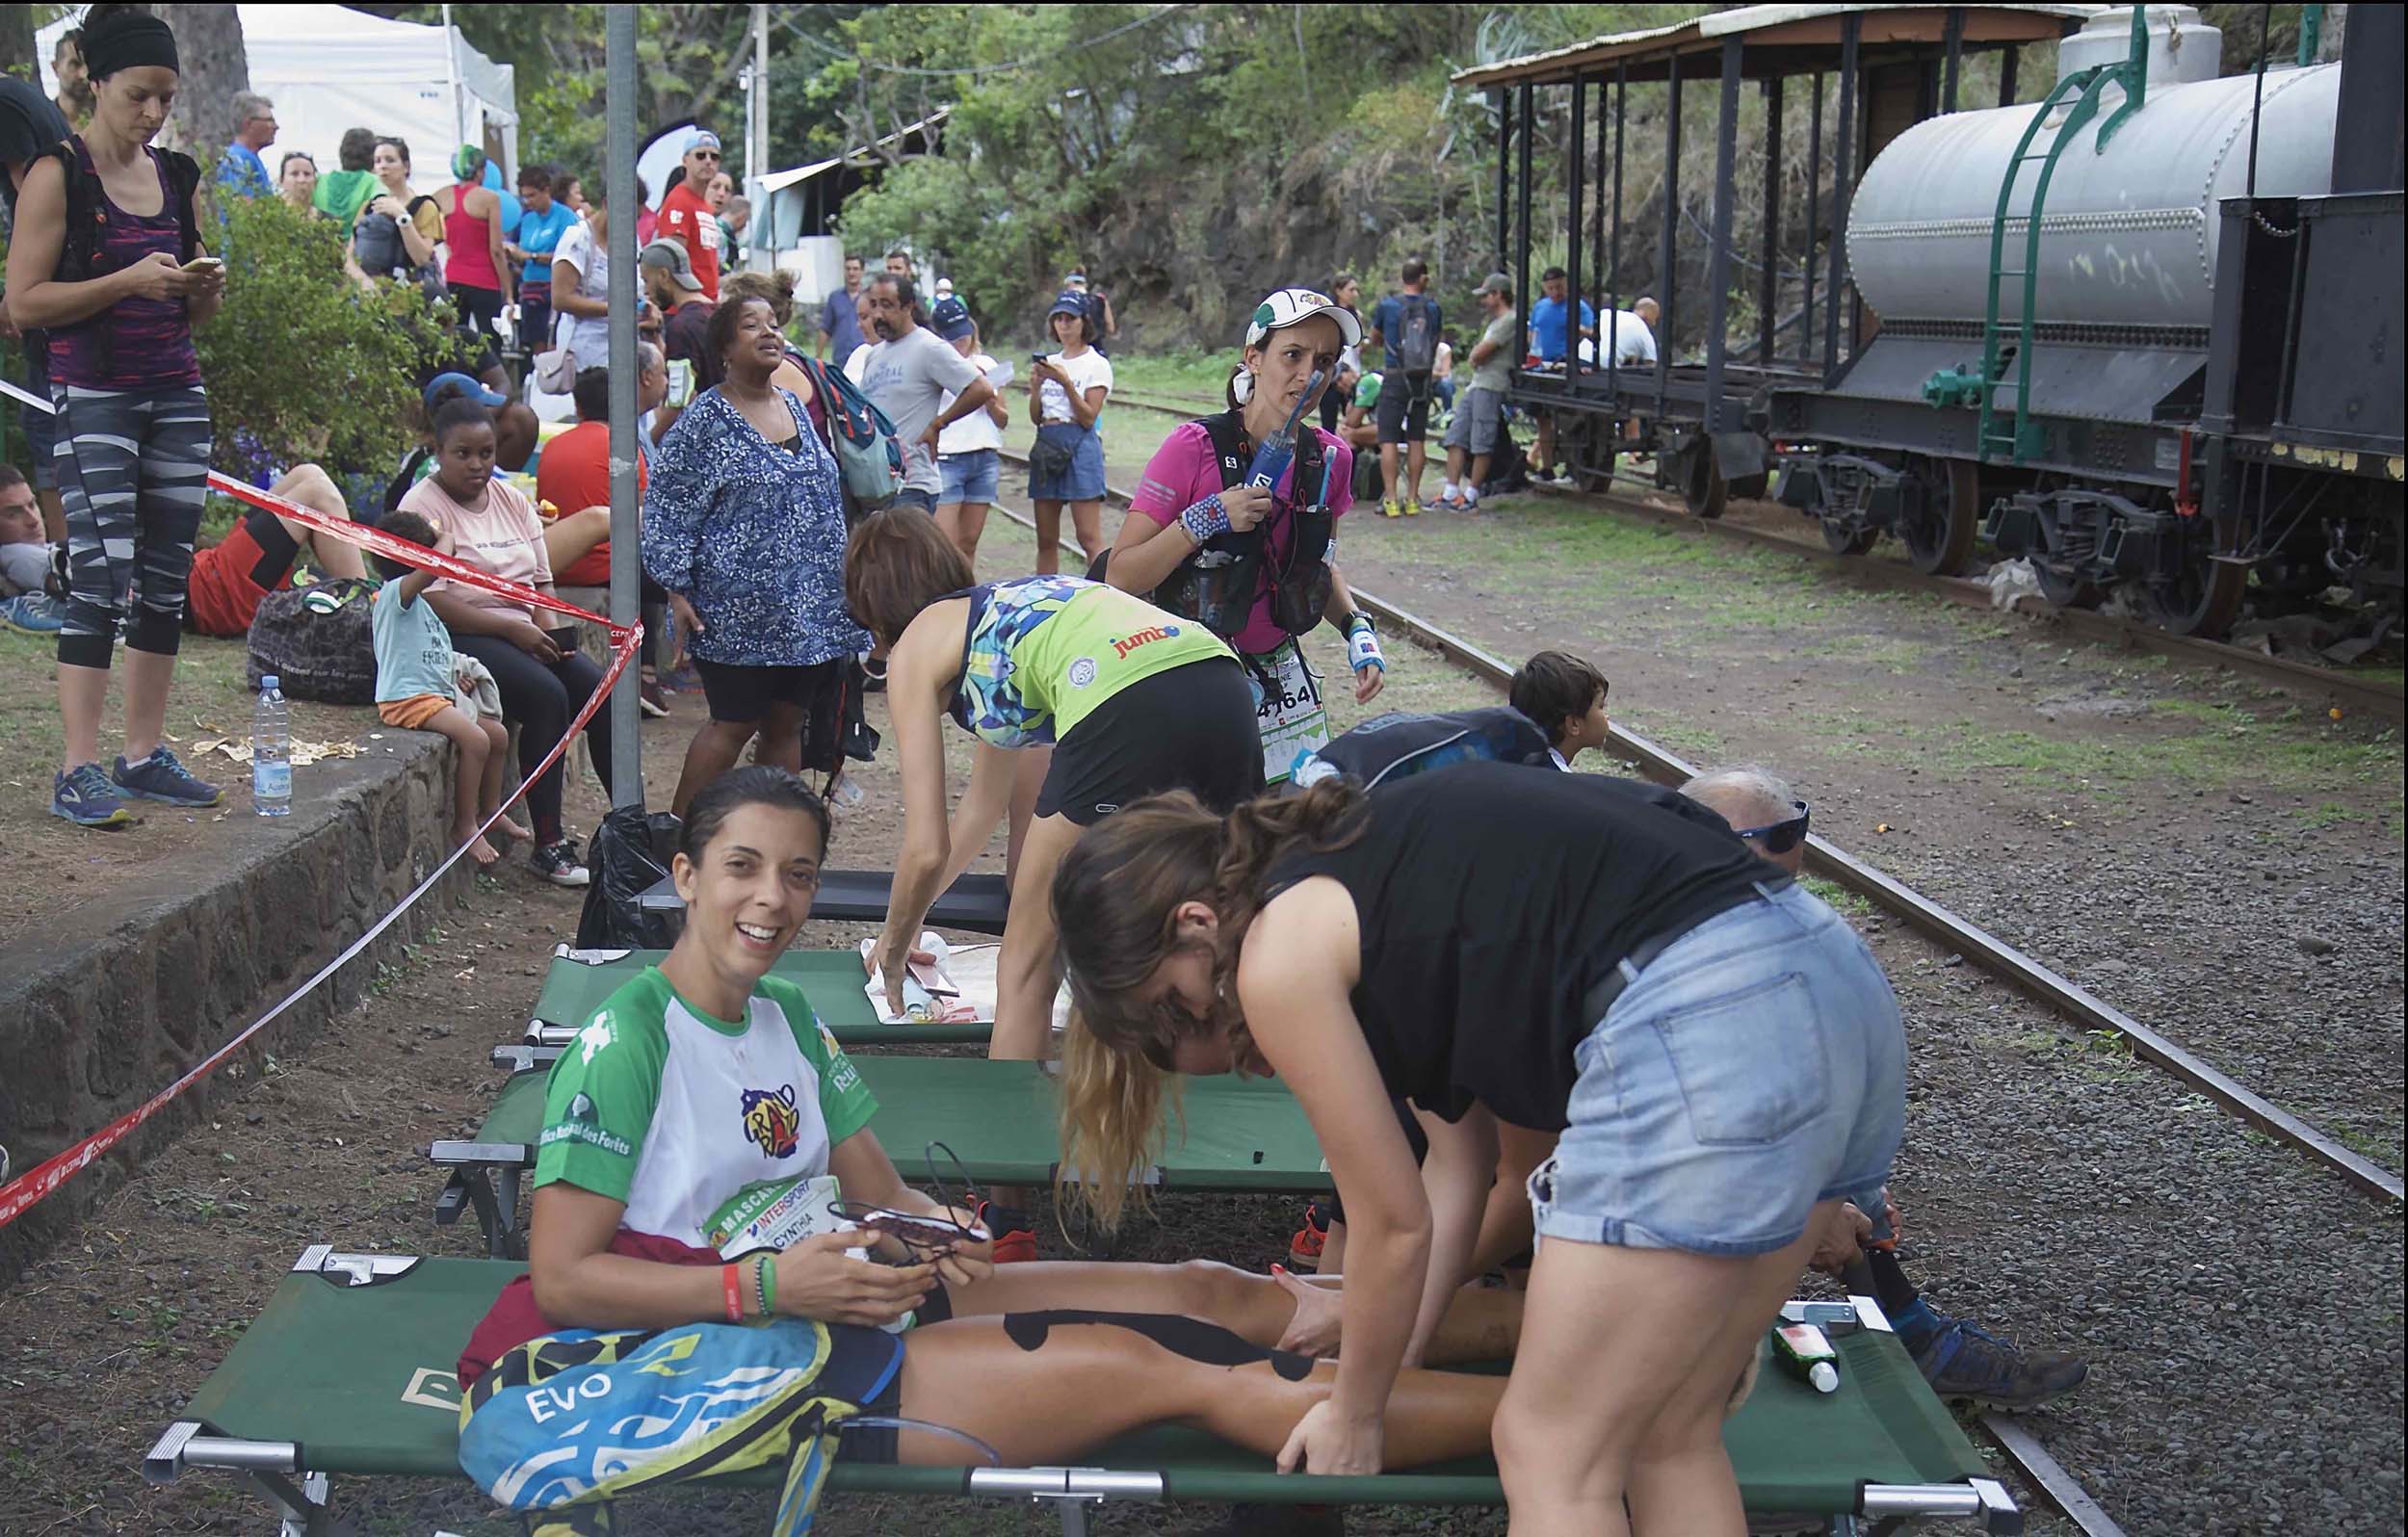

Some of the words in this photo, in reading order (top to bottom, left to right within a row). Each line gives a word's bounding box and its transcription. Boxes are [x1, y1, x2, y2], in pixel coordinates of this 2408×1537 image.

[1110, 626, 1180, 660] jumbo
[583, 1126, 599, 1144] des
[597, 1130, 630, 1156] Forêts
[756, 1179, 811, 1230] INTERSPORT
[773, 1212, 814, 1249] CYNTHIA
[525, 1372, 613, 1424] EVO
